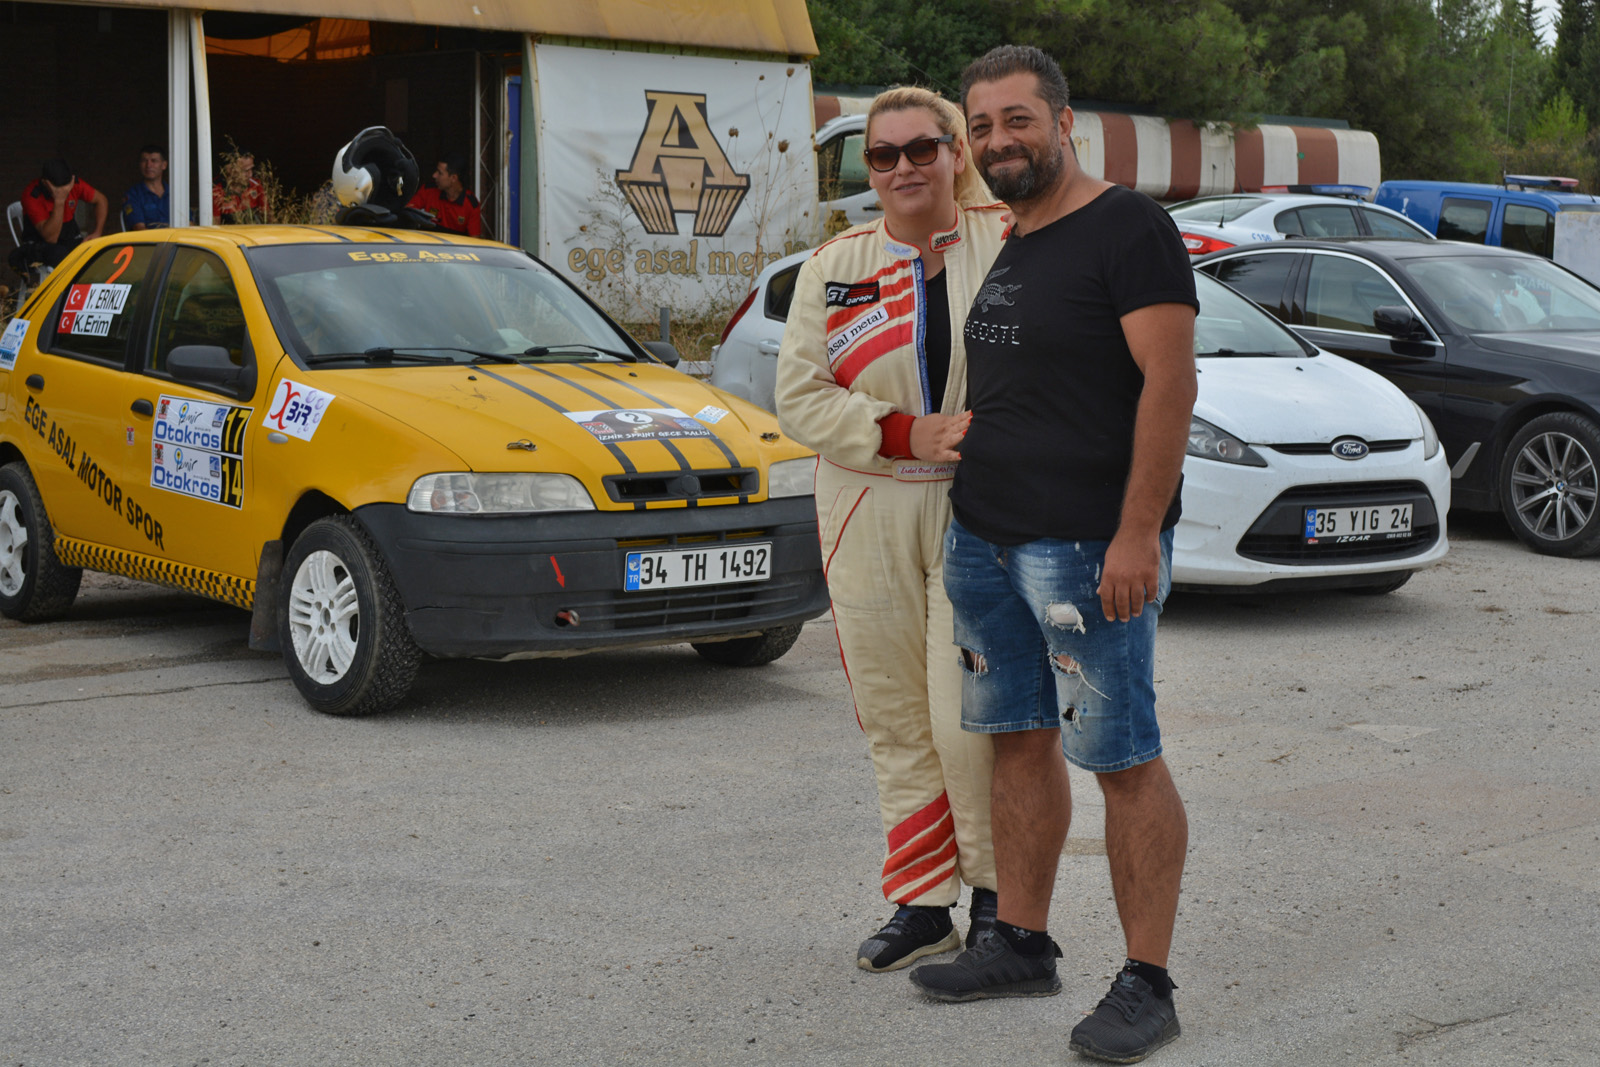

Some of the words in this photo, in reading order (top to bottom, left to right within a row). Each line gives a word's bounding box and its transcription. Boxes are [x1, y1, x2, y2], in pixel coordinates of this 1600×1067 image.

[105, 246, 134, 284] 2
[348, 251, 408, 262] Ege
[419, 250, 480, 262] Asal
[567, 247, 625, 281] ege
[634, 239, 699, 275] asal
[845, 294, 874, 306] garage
[72, 314, 109, 334] K.Erim
[828, 334, 850, 356] asal
[850, 311, 884, 338] metal
[155, 420, 220, 449] Otokros
[224, 408, 251, 453] 17
[624, 412, 646, 423] 2
[1341, 443, 1363, 455] Ford
[24, 395, 47, 439] EGE
[48, 421, 76, 472] ASAL
[77, 451, 123, 517] MOTOR
[126, 497, 165, 551] SPOR
[153, 465, 220, 499] Otokros
[222, 458, 243, 506] 14
[1307, 525, 1315, 533] TR
[1315, 511, 1337, 534] 35
[1350, 509, 1379, 532] YIG
[1390, 507, 1410, 530] 24
[628, 574, 639, 584] TR
[640, 556, 668, 585] 34
[682, 552, 707, 582] TH
[720, 548, 767, 579] 1492
